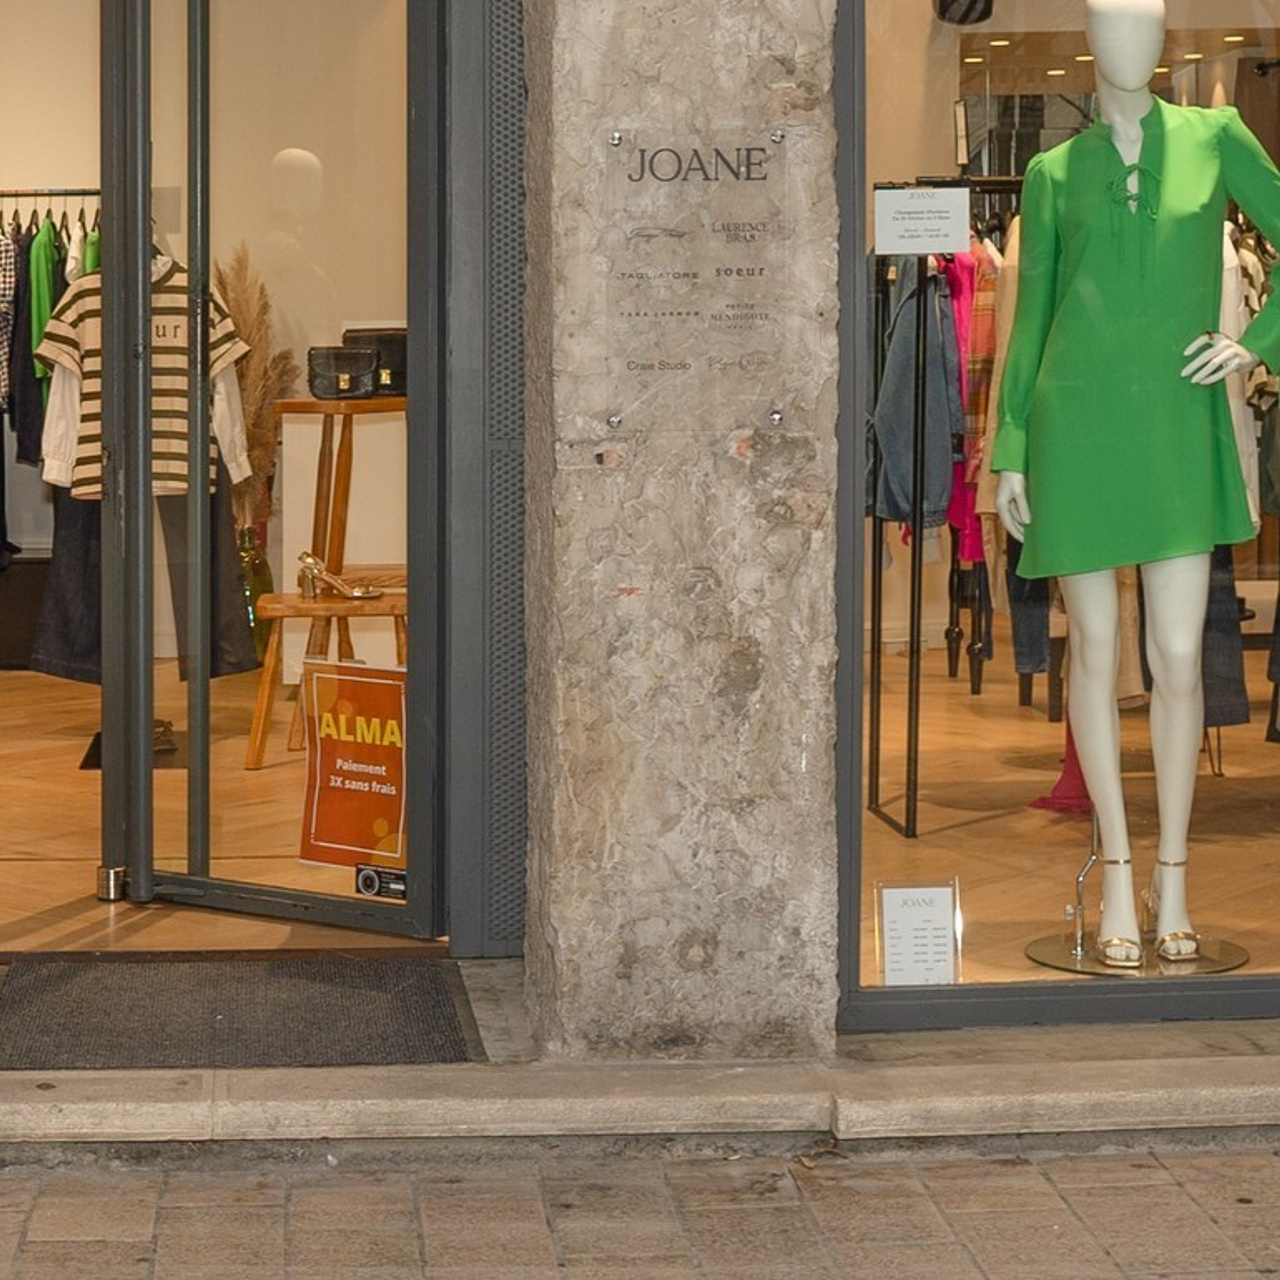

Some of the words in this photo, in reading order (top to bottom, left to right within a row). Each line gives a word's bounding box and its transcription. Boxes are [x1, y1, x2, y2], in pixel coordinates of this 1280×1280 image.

[627, 148, 768, 182] JOANE
[711, 222, 770, 233] LAURENCE
[715, 267, 766, 277] soeur
[320, 712, 402, 748] ALMA
[336, 758, 387, 776] Paiement
[329, 775, 343, 788] 3X
[344, 779, 370, 792] sans
[371, 781, 396, 796] frais
